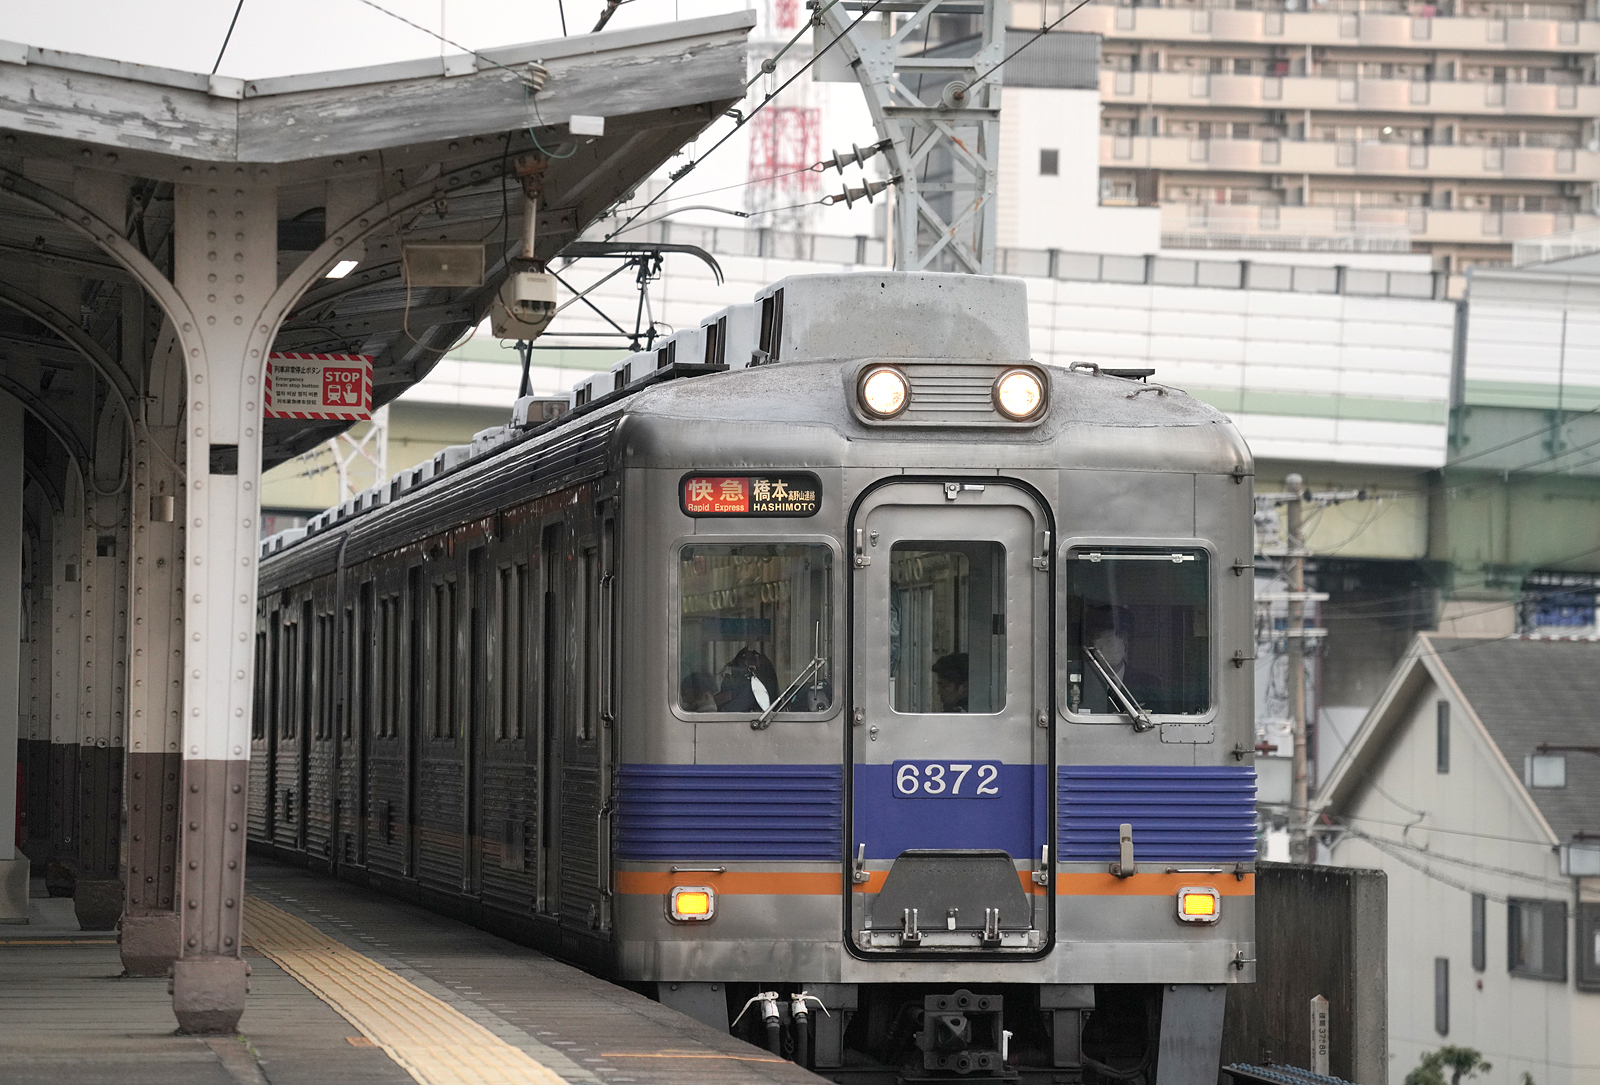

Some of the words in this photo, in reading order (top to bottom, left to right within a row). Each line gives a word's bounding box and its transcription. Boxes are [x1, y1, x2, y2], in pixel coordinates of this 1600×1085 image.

[274, 366, 321, 374] 列車非常停止ボタン
[325, 371, 360, 383] STOP
[688, 479, 744, 502] 快急
[753, 479, 788, 502] 橋本
[688, 503, 710, 513] Rapid
[714, 503, 745, 513] Express
[753, 502, 816, 512] HASHIMOTO
[896, 764, 999, 795] 6372
